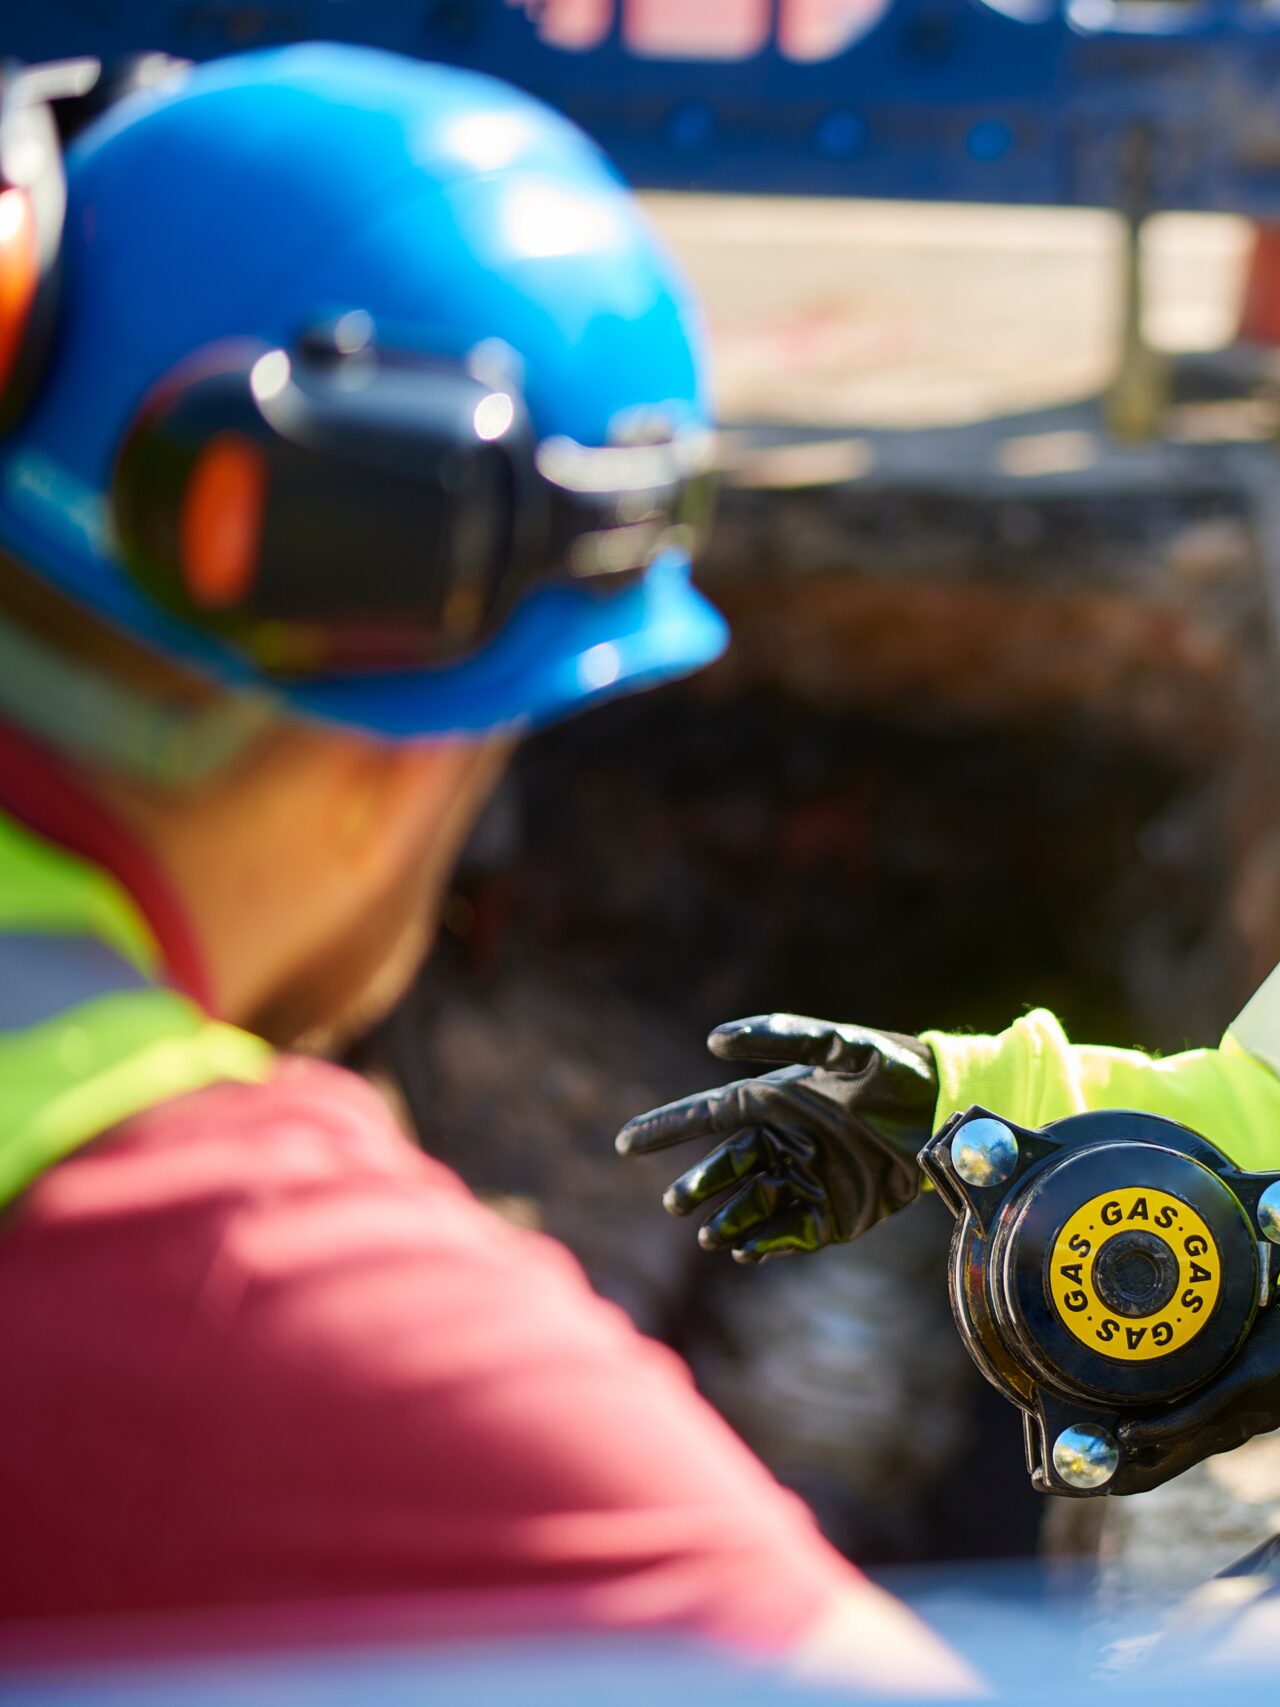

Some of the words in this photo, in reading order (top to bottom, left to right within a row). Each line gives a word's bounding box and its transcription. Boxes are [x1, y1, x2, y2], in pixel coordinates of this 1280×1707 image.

[1101, 1198, 1179, 1229] GAS
[1060, 1233, 1092, 1312] GAS
[1181, 1235, 1212, 1314] GAS
[1095, 1318, 1174, 1350] GAS
